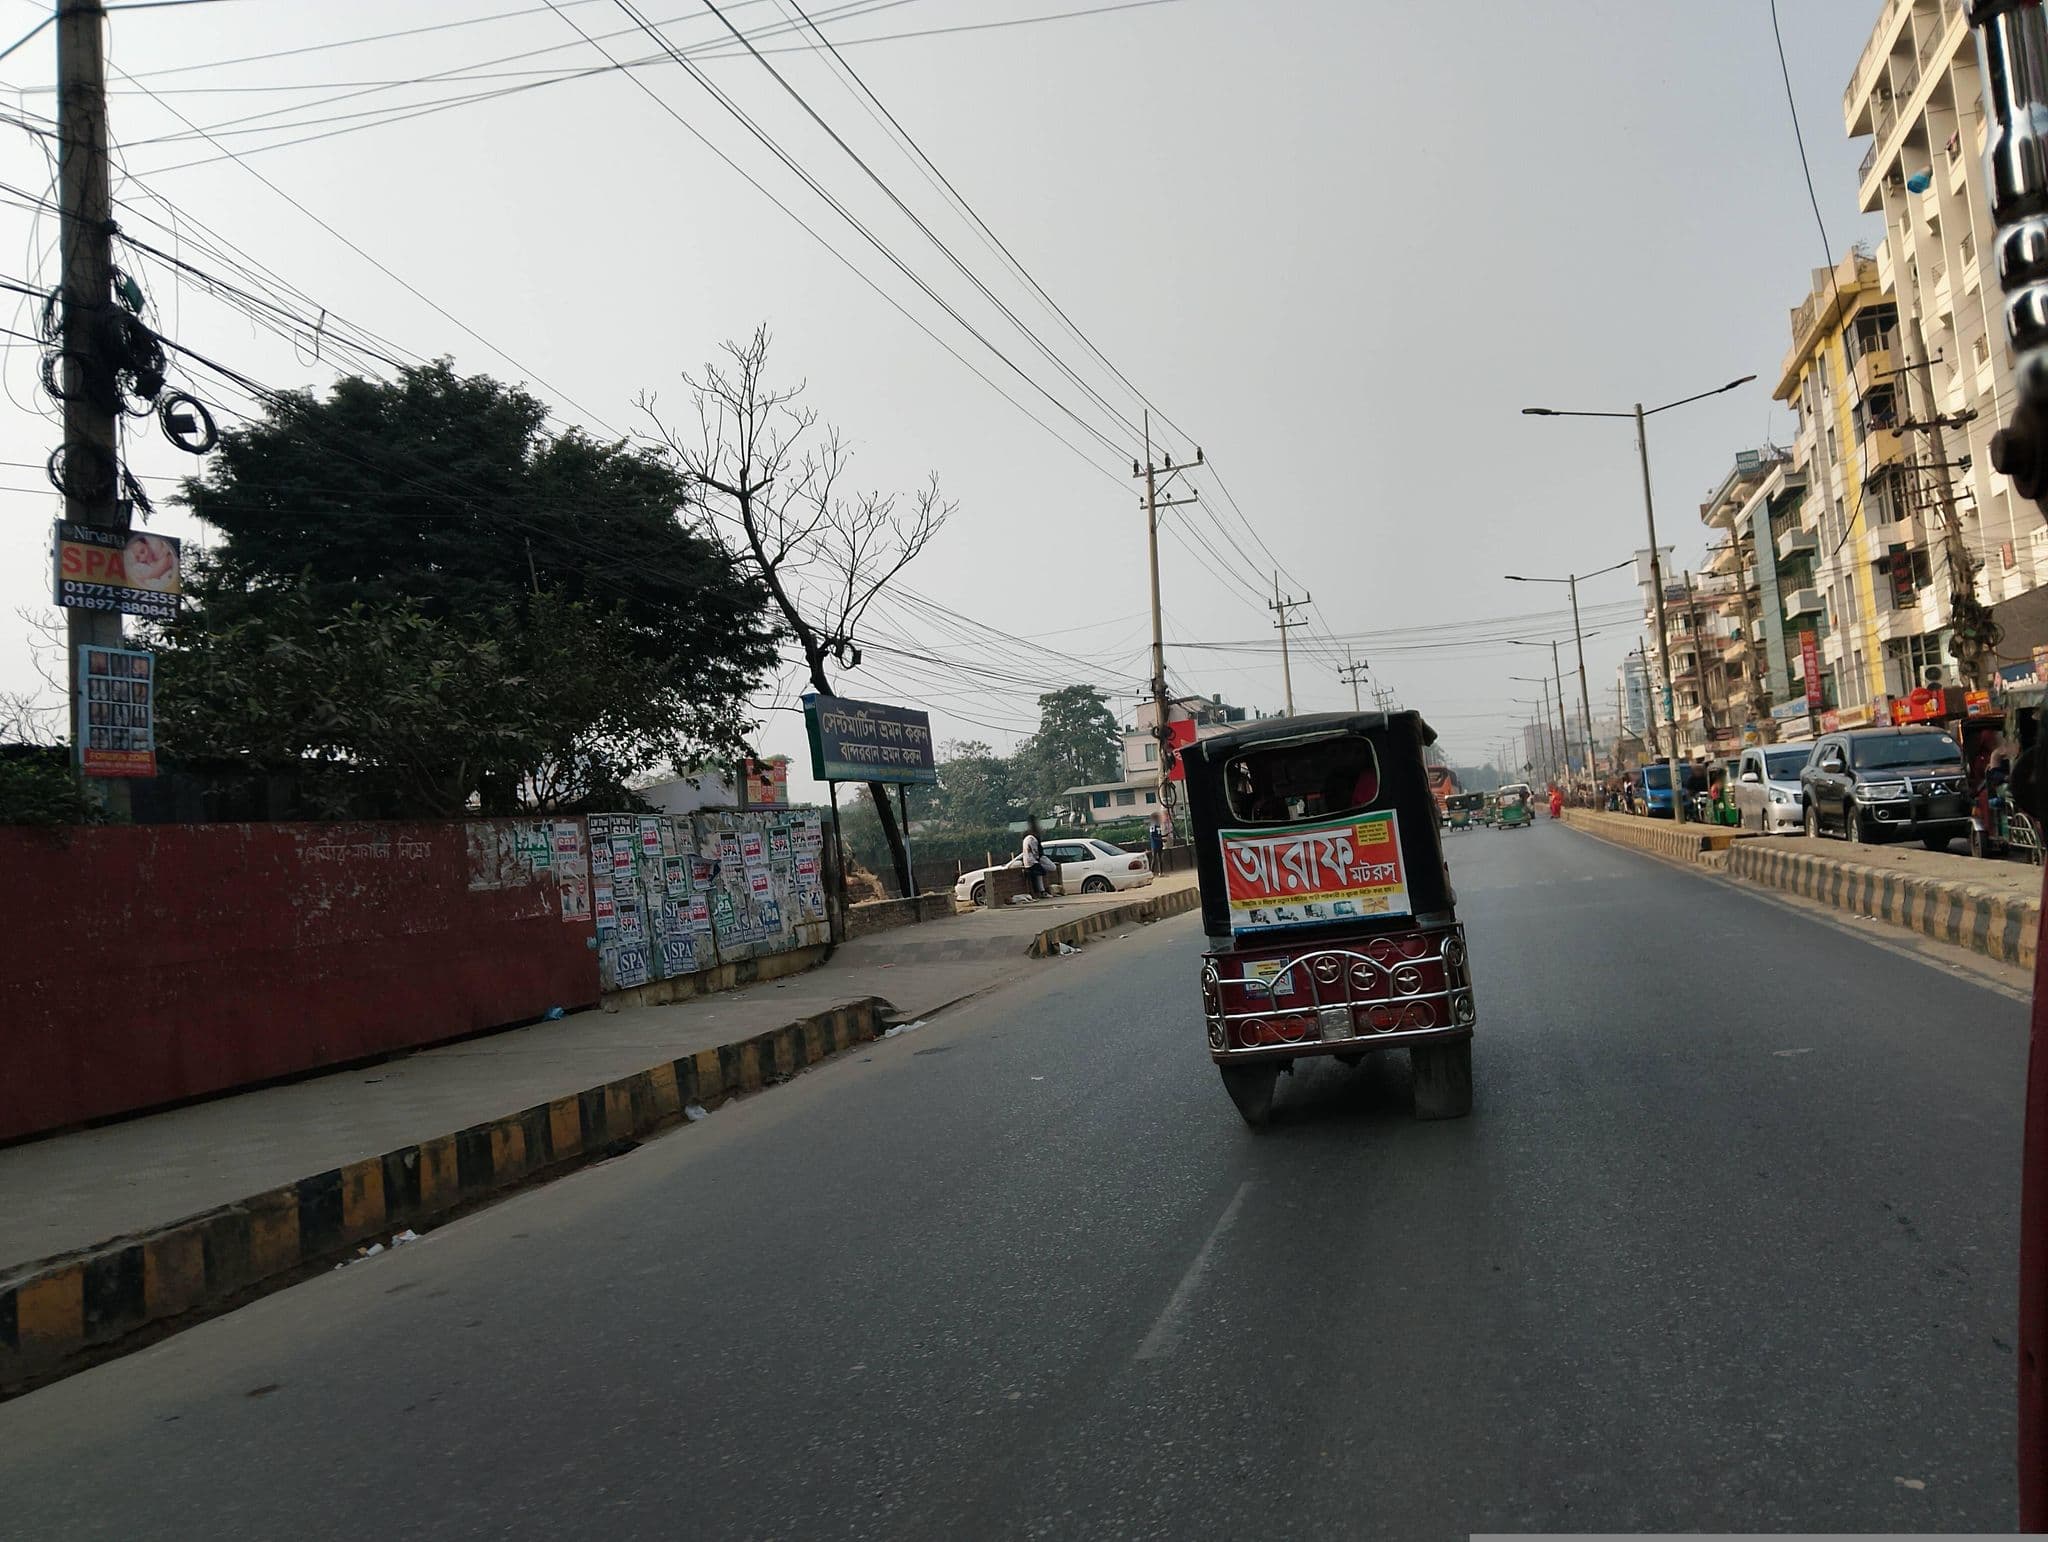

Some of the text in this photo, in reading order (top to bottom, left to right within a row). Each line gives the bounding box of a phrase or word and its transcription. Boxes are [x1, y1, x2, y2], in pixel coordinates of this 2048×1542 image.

[63, 546, 128, 581] SPA
[64, 581, 177, 605] 01771-572555
[64, 595, 177, 618] 01897-880841
[822, 708, 877, 738] সেন্টমার্টিন
[903, 724, 929, 744] করুন
[839, 742, 880, 763] বান্দরবান
[1227, 827, 1354, 895] আরাফ
[665, 902, 678, 918] SP
[622, 919, 637, 931] SPA
[671, 940, 692, 958] SPA
[622, 952, 645, 971] SPA
